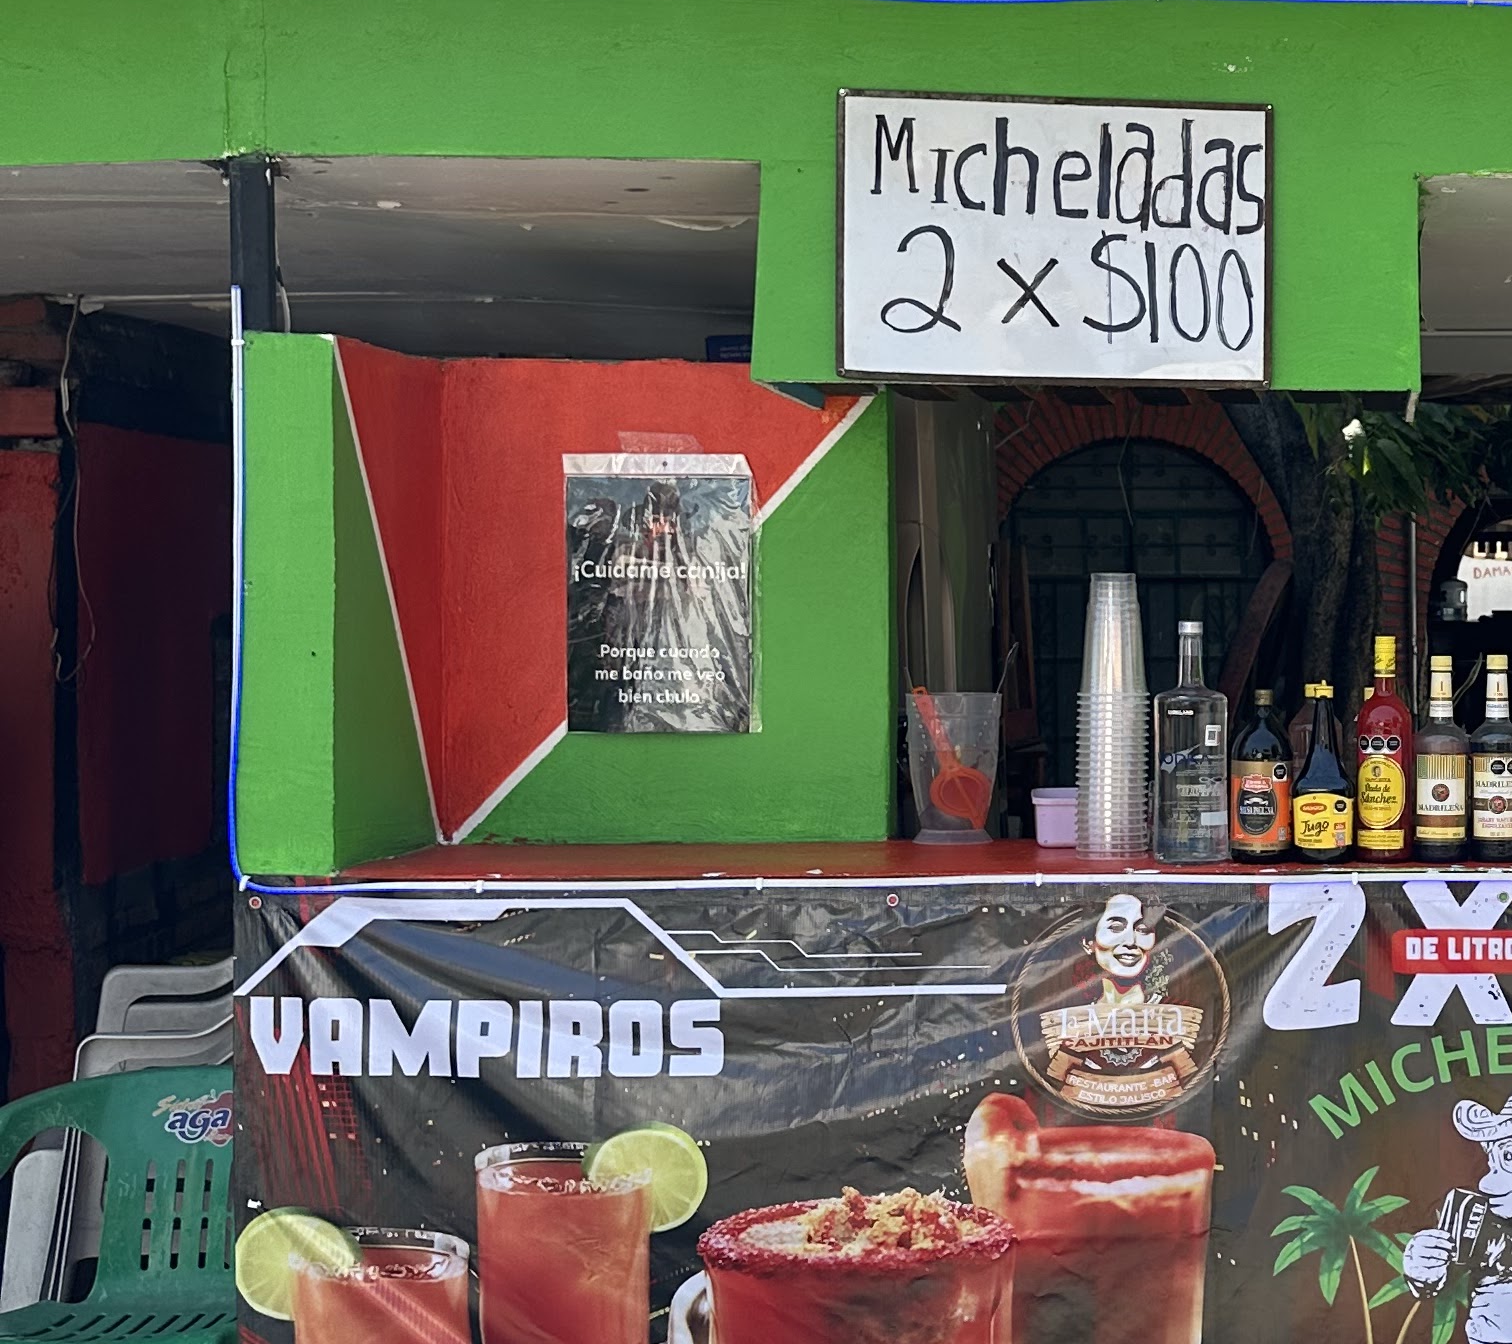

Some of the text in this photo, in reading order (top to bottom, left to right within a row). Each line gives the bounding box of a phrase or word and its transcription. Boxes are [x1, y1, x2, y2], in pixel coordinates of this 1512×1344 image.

[870, 113, 1265, 235] Micheladas
[881, 224, 962, 334] 2
[1083, 229, 1255, 351] $100
[599, 644, 720, 662] Porque cuando
[595, 666, 726, 682] me baño me veo
[618, 688, 653, 704] bien
[1300, 820, 1330, 837] Jugo
[1263, 881, 1369, 1031] 2
[1405, 936, 1440, 961] DE
[249, 995, 725, 1079] VAMPIROS
[1068, 1074, 1148, 1093] RESTAURANTE
[1078, 1089, 1167, 1104] ESTILO JALISCO
